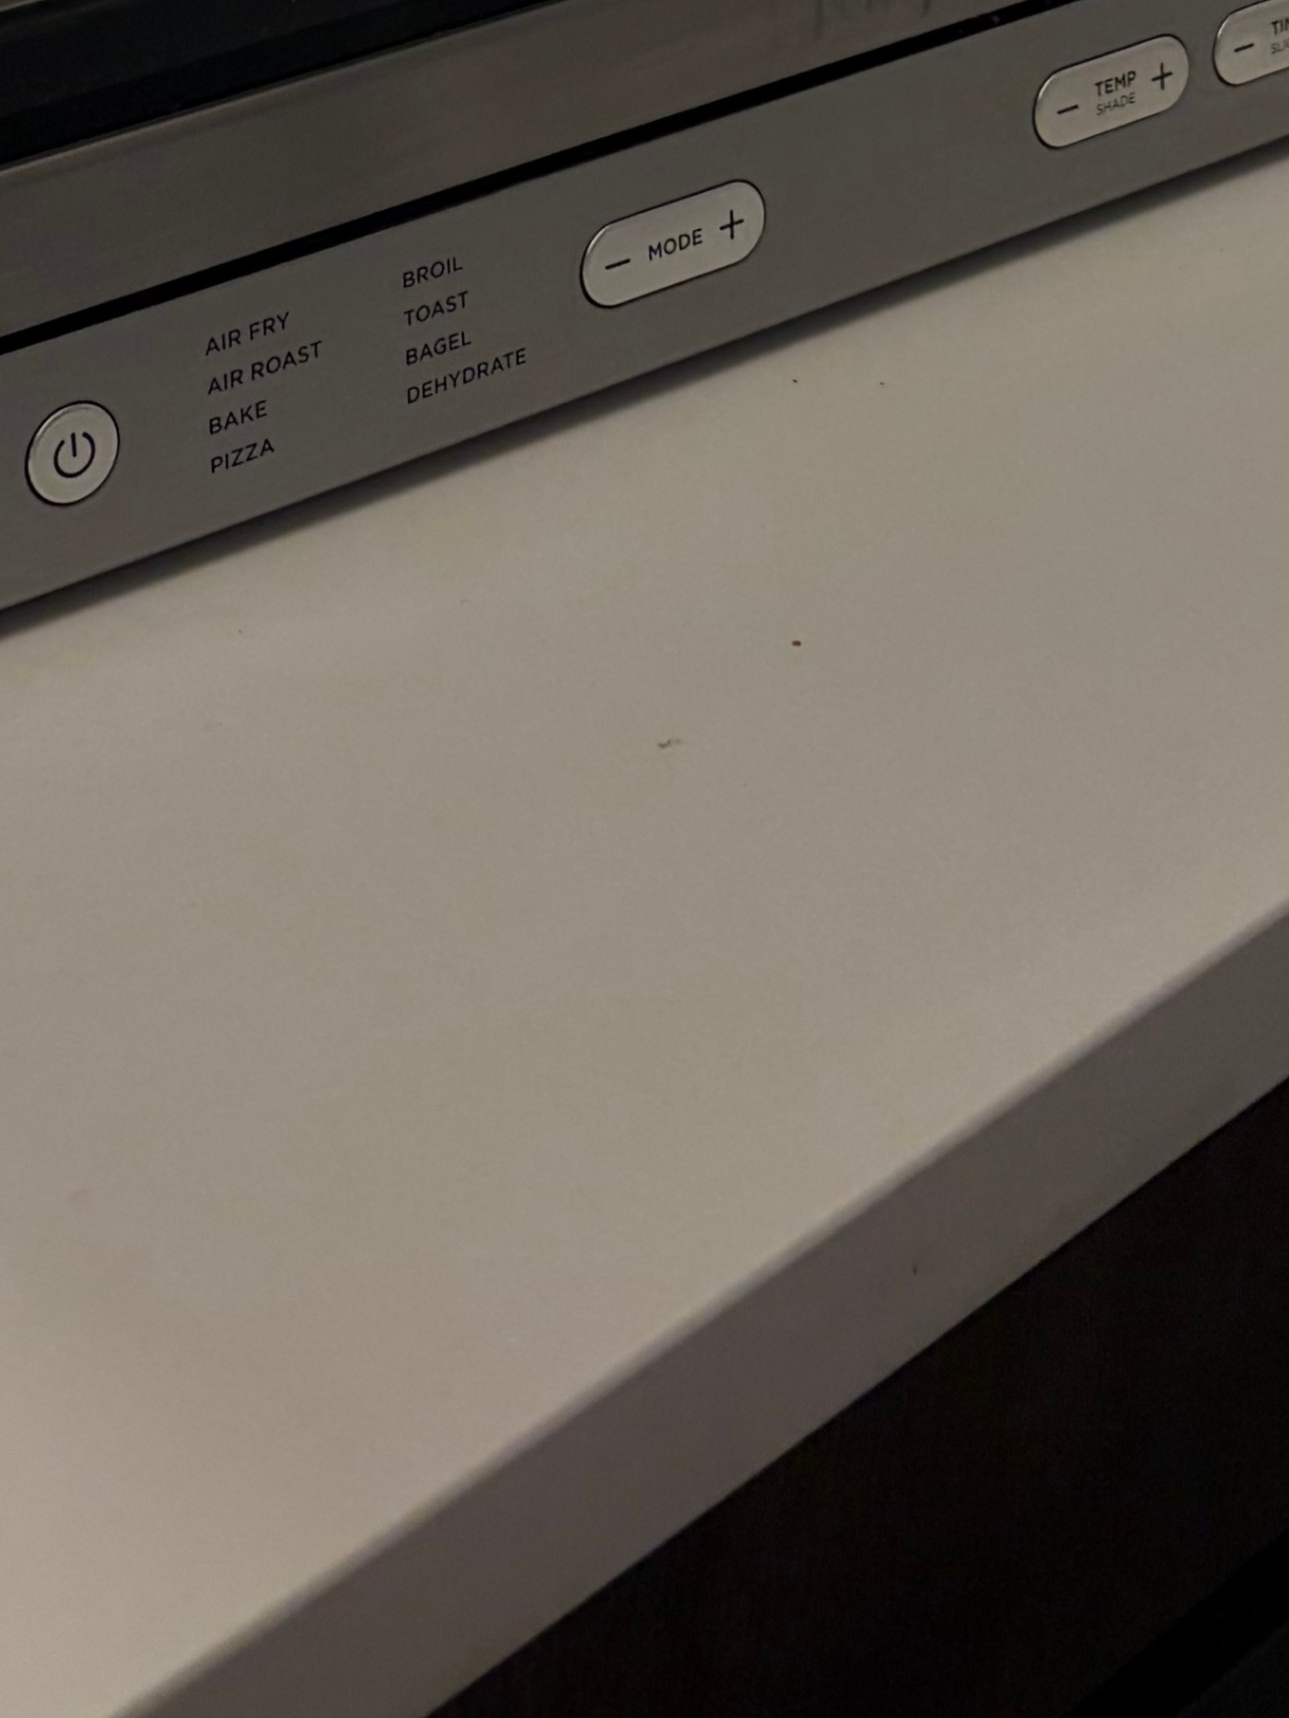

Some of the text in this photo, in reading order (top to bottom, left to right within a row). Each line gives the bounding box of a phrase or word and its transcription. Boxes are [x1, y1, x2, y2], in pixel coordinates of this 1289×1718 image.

[1093, 70, 1137, 97] TEMP
[1095, 91, 1137, 116] SHADE
[648, 227, 704, 262] MODE
[402, 256, 464, 289] BROIL
[403, 290, 469, 327] TOAST
[205, 311, 290, 357] AIR FRY
[405, 330, 472, 366] BAGEL
[207, 340, 323, 396] AIR ROAST
[406, 347, 527, 405] DEHYDRATE
[208, 399, 268, 436] BAKE
[210, 438, 275, 474] PIZZA
